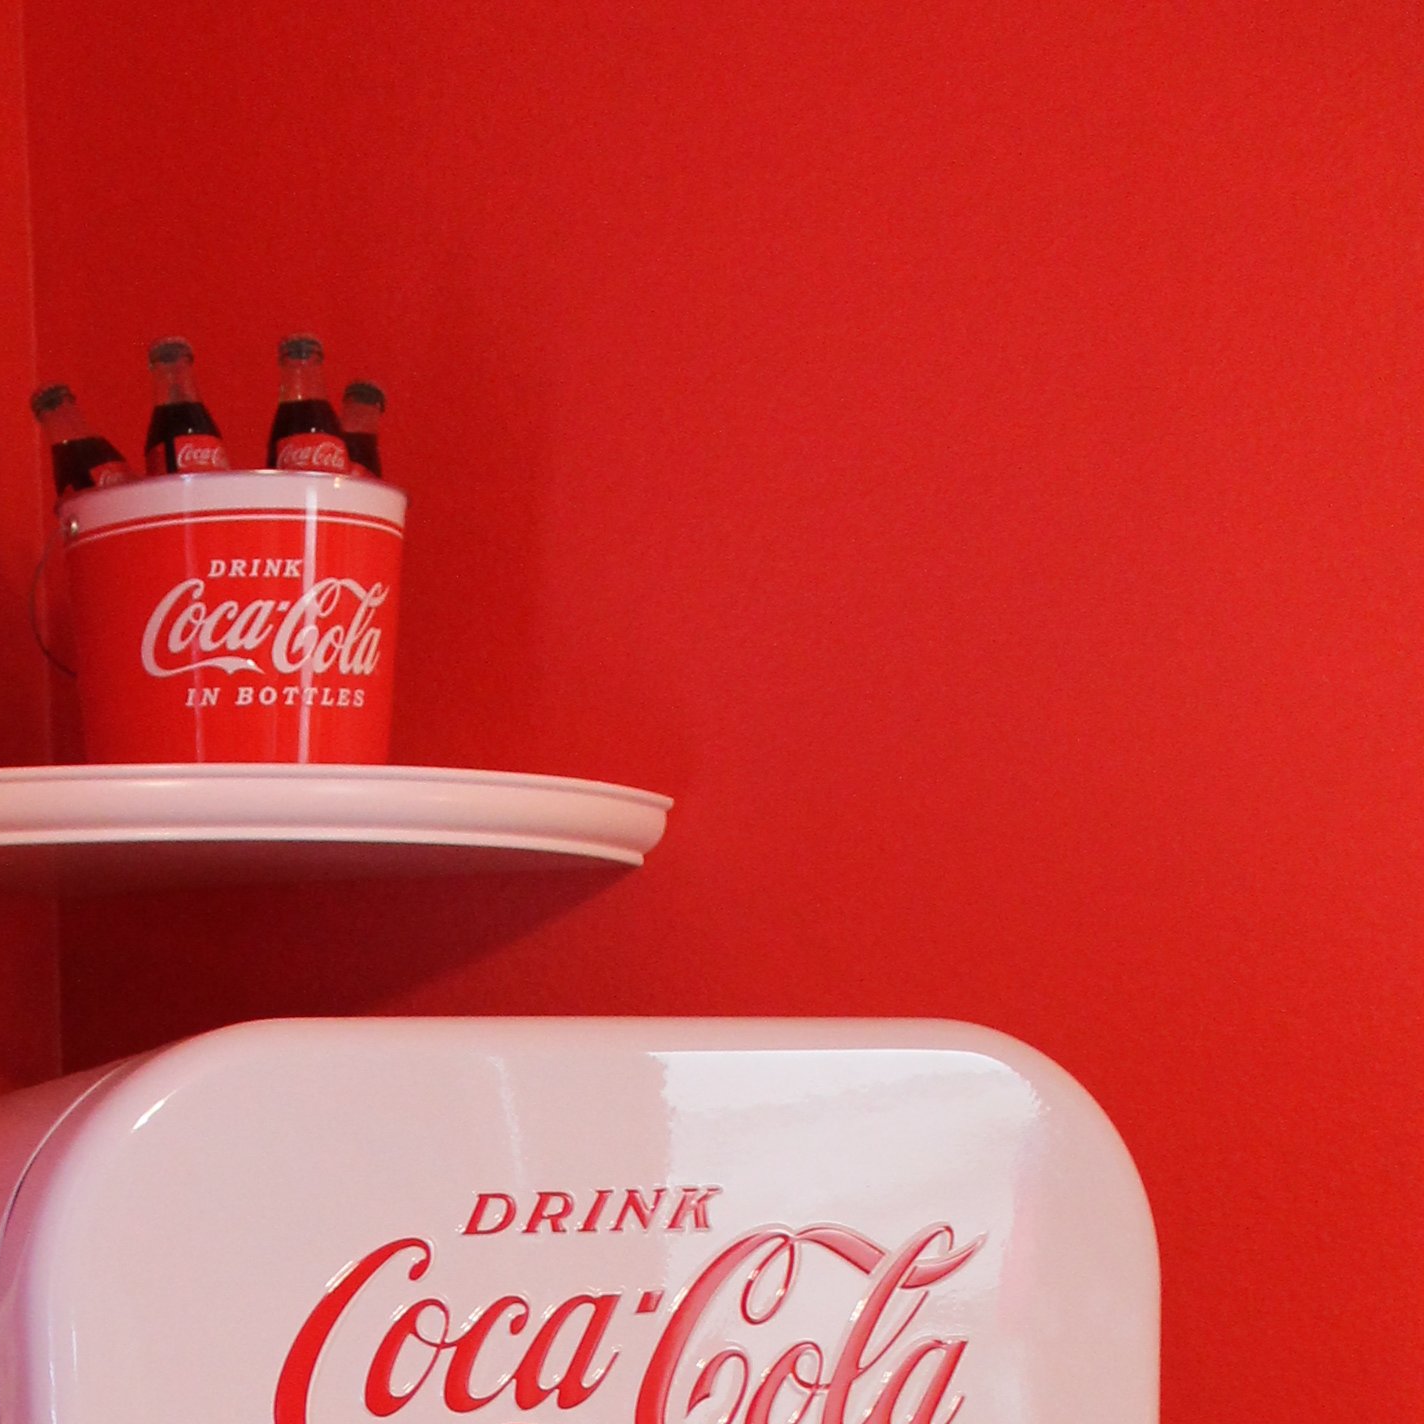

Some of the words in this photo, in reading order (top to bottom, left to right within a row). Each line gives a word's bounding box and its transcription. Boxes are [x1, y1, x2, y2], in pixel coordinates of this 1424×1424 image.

[208, 559, 304, 579] DRINK
[141, 577, 390, 679] Coca-Cola
[186, 687, 221, 707] IN
[235, 686, 366, 708] BOTTLES
[462, 1185, 724, 1236] DRINK
